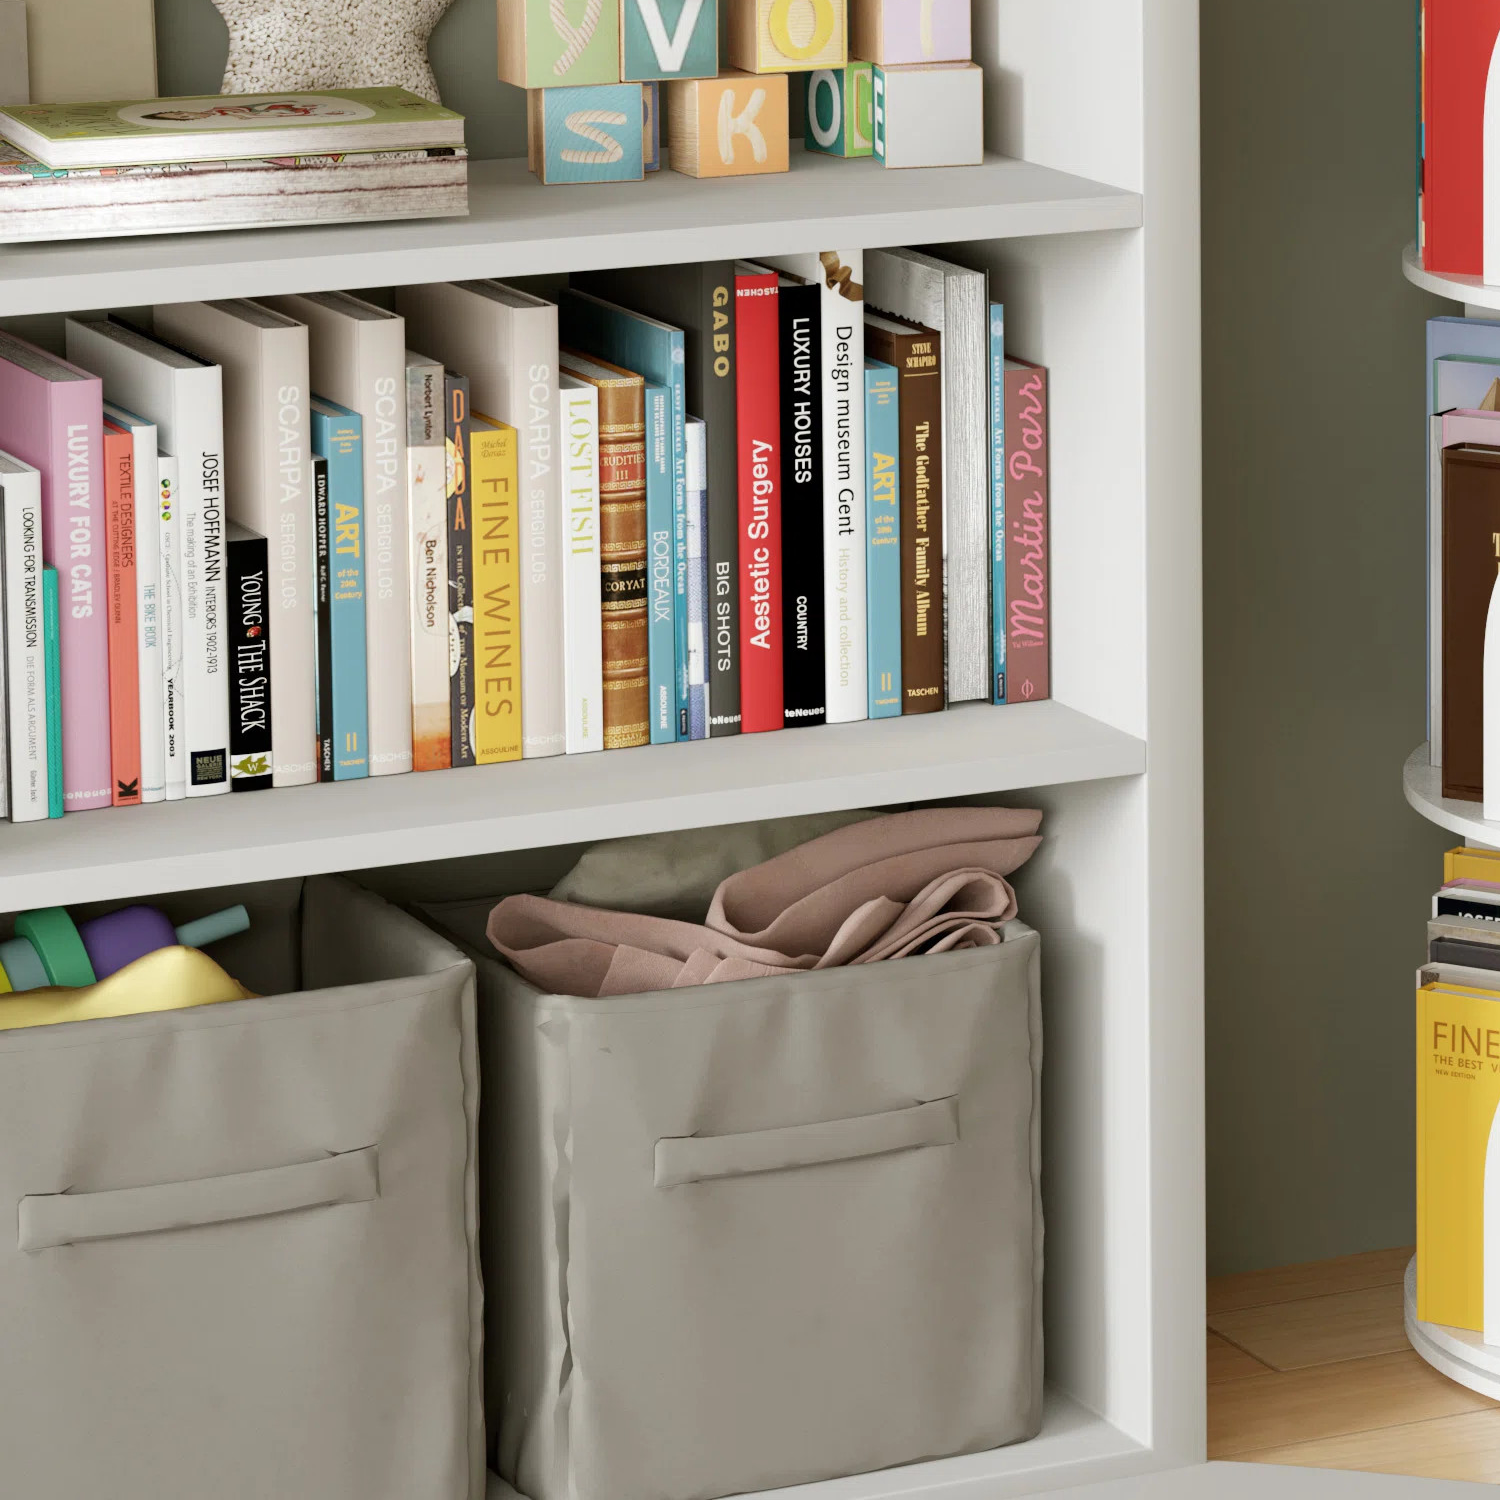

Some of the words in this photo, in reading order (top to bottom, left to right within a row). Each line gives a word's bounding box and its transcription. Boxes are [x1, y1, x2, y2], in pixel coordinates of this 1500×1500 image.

[560, 110, 629, 164] S
[717, 88, 766, 164] K
[737, 287, 778, 297] TASCHEN
[713, 287, 729, 377] GABO
[912, 343, 931, 354] STEVE
[793, 318, 810, 395] LUXURY
[832, 327, 852, 391] Design
[906, 355, 936, 368] SCHAPIRO
[276, 386, 300, 504] SCARPA
[375, 378, 397, 494] SCARPA
[423, 410, 432, 440] Lynton
[570, 400, 592, 476] LOST
[794, 402, 811, 483] HOUSES
[838, 400, 852, 480] museum
[916, 422, 929, 451] The
[1010, 372, 1046, 480] Parr
[68, 425, 90, 508] LUXURY
[120, 454, 131, 499] TEXTILE
[203, 452, 219, 492] JOSEF
[453, 390, 465, 530] DADA
[873, 453, 895, 504] ART
[317, 472, 325, 518] EDWARD
[748, 440, 773, 539] Surgery
[839, 489, 854, 535] Gent
[916, 455, 929, 532] Godfather
[23, 508, 34, 552] LOOKING
[70, 516, 91, 558] FOR
[118, 503, 136, 567] DESIGNERS
[184, 528, 196, 557] making
[204, 498, 220, 581] HOFFMANN
[280, 510, 296, 574] SERGIO
[318, 519, 326, 557] HOPPER
[336, 503, 359, 557] ART
[375, 504, 392, 562] SERGIO
[571, 488, 593, 553] FISH
[24, 555, 35, 573] FOR
[426, 540, 436, 563] Ben
[836, 548, 850, 593] History
[915, 537, 929, 586] Family
[1011, 491, 1044, 638] Martin
[71, 564, 93, 618] CATS
[188, 581, 197, 618] Exhibition
[241, 571, 263, 625] YOUNG
[280, 575, 296, 609] LOS
[378, 566, 392, 599] LOS
[426, 568, 436, 627] Nicholson
[606, 578, 645, 592] CORYAT
[653, 531, 669, 622] BORDEAUX
[716, 562, 729, 595] BIG
[748, 548, 770, 649] Aestetic
[25, 575, 37, 647] TRANSMISSION
[206, 587, 216, 630] INTERIORS
[797, 596, 807, 650] COUNTRY
[840, 598, 851, 620] and
[917, 591, 930, 636] Album
[207, 632, 217, 673] 1902-1913
[238, 640, 265, 673] THE
[717, 603, 730, 671] SHOTS
[840, 626, 852, 686] collection
[27, 671, 35, 695] FORM
[239, 677, 267, 733] SHACK
[907, 687, 938, 696] TASCHEN
[785, 707, 824, 717] teNeues
[28, 714, 37, 760] ARGUMENT
[196, 755, 222, 763] NEUE
[481, 745, 518, 755] ASSOULINE
[118, 778, 138, 797] K
[1433, 1021, 1500, 1059] FINE
[1433, 1054, 1453, 1066] THE
[1457, 1058, 1483, 1070] BEST
